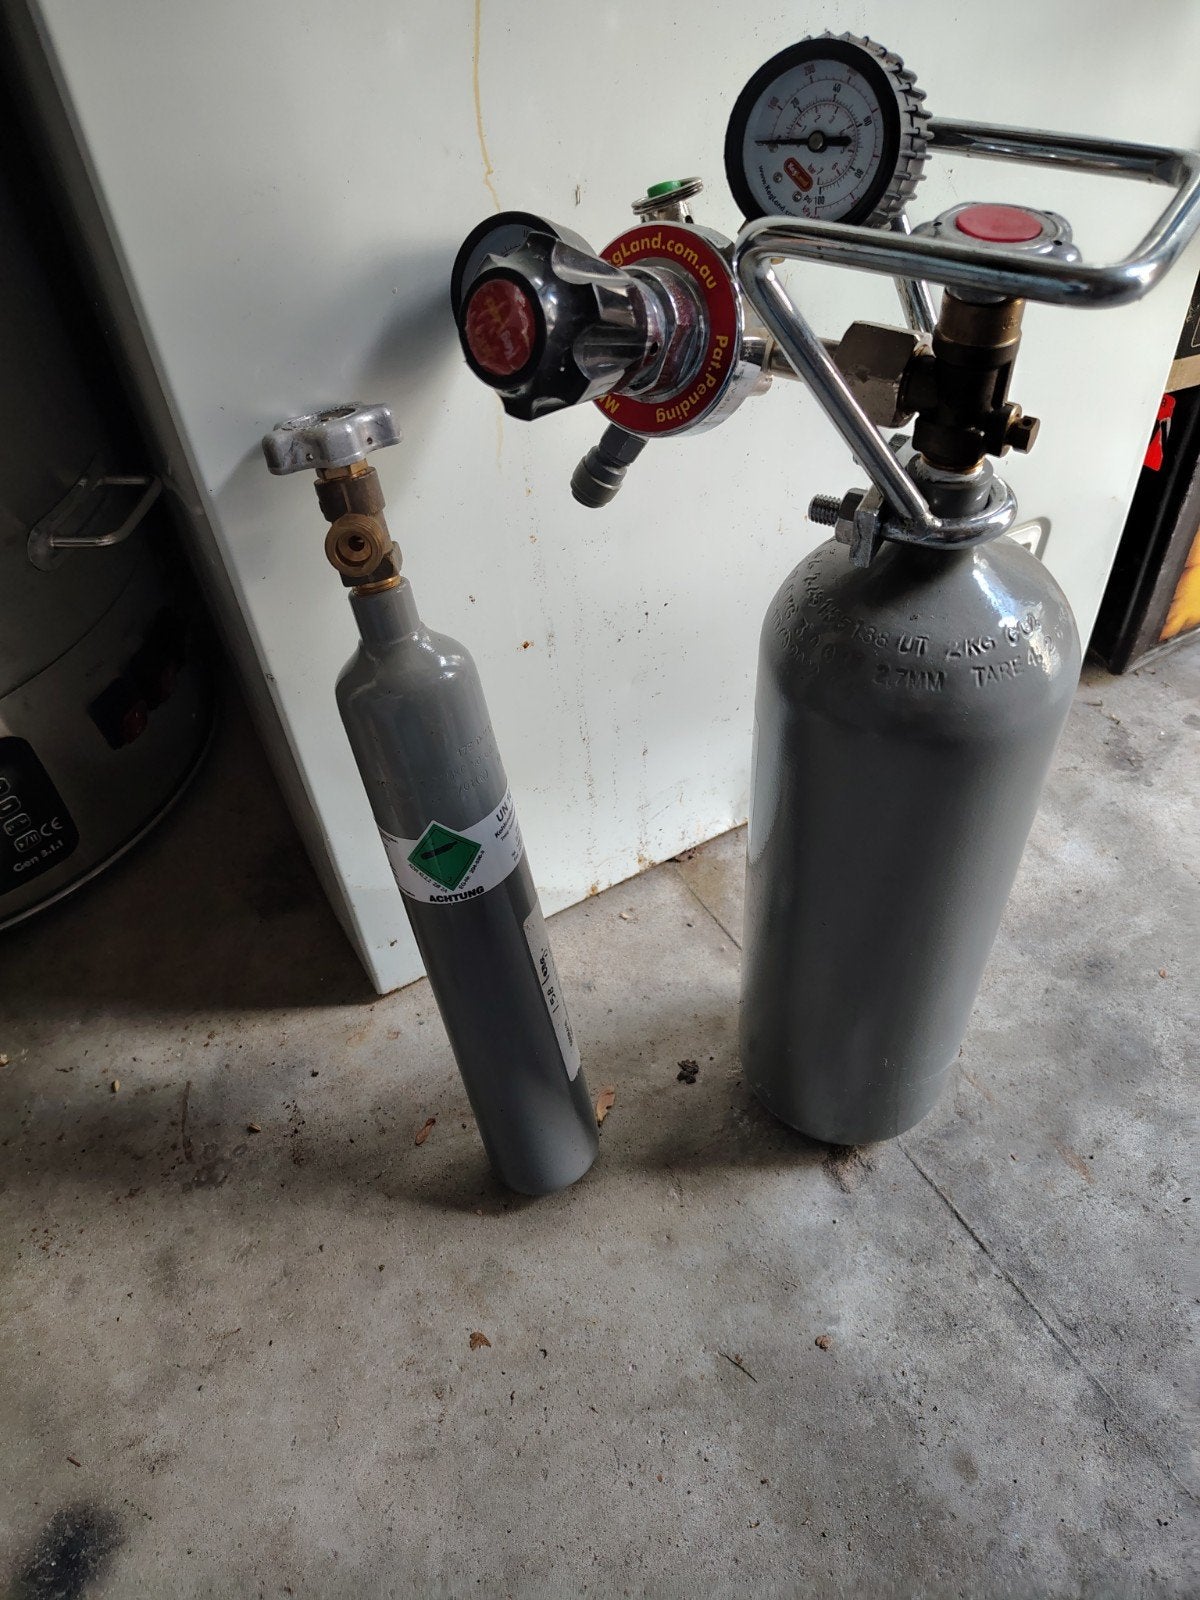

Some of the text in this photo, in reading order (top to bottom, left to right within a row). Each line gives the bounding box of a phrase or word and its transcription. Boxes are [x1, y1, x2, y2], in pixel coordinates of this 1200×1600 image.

[607, 232, 718, 290] gLand.com.au
[971, 659, 1025, 688] TARE
[496, 804, 509, 823] UN
[429, 885, 485, 903] ACHTUNG
